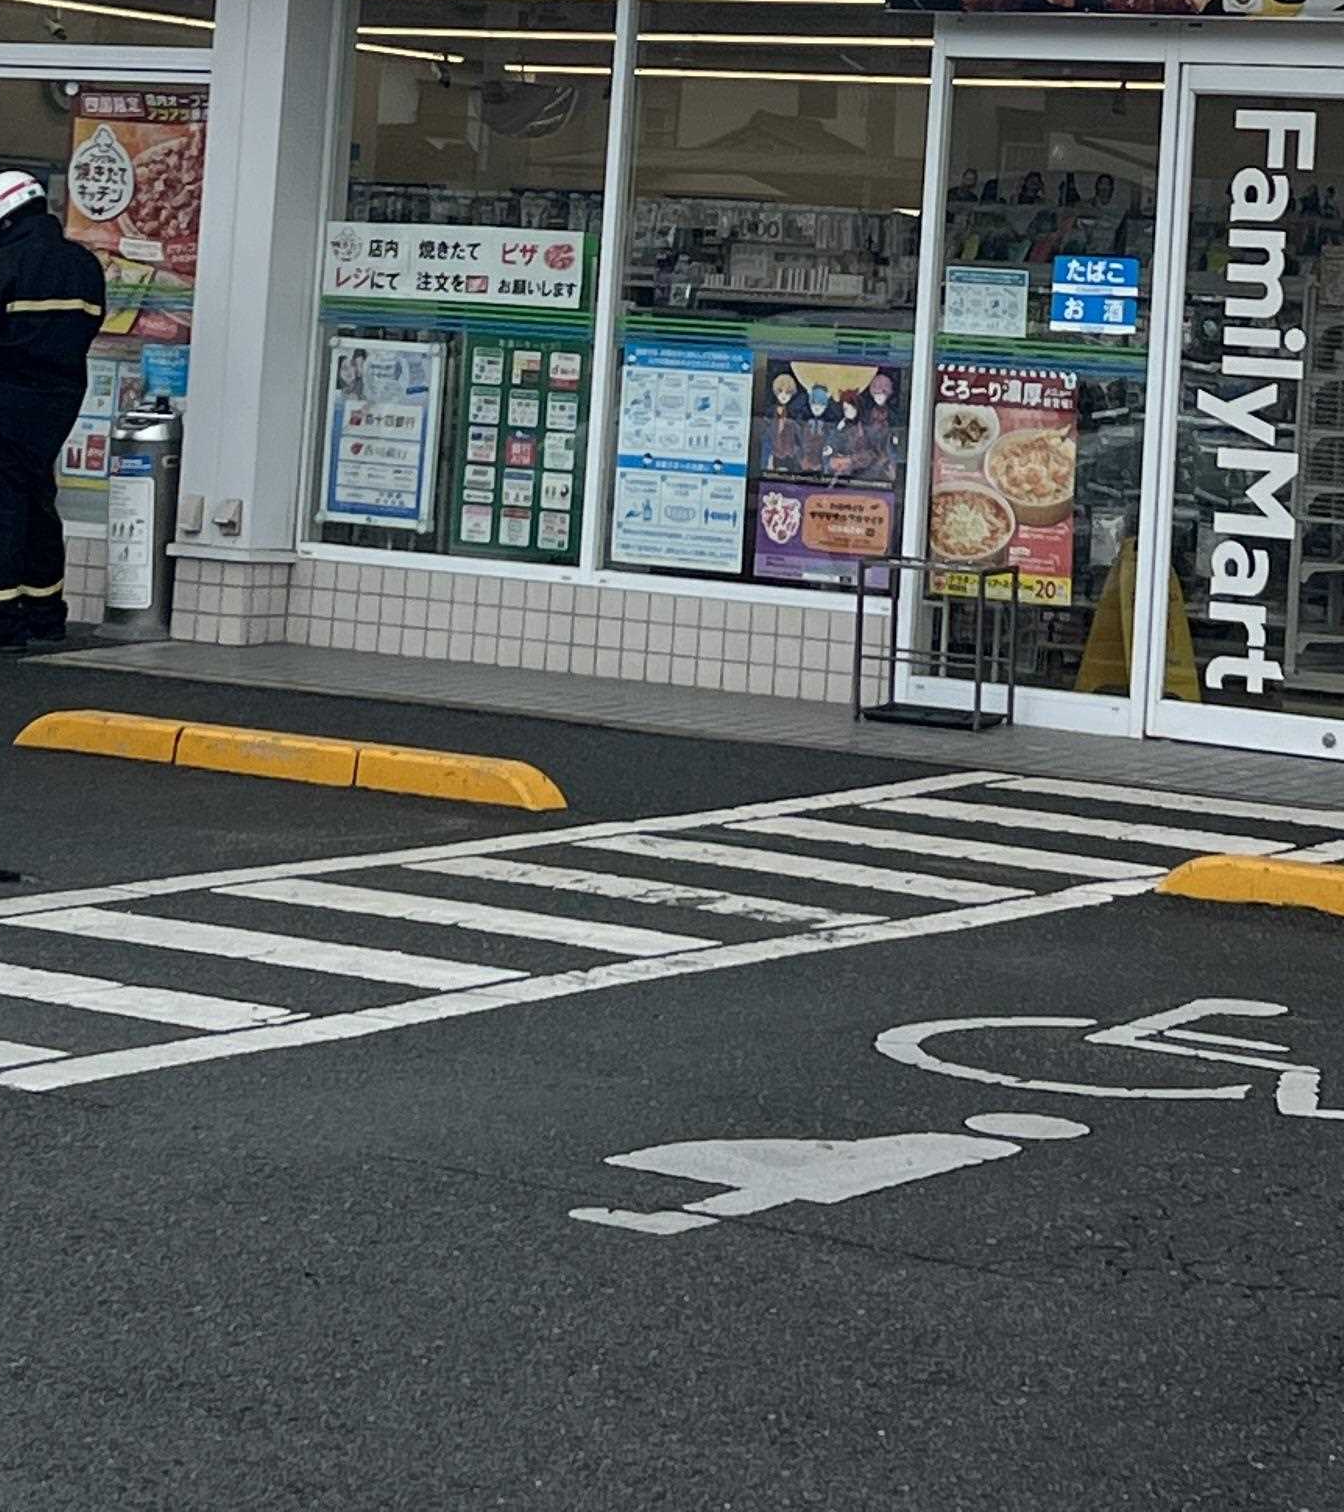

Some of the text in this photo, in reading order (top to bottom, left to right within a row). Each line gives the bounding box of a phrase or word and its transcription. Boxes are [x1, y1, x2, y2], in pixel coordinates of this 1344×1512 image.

[367, 239, 399, 259] 店内
[418, 239, 481, 260] 焼きたて
[501, 243, 539, 266] ピザ
[335, 266, 578, 299] レジにて 注文を お願いします
[1065, 258, 1126, 284] たばこ
[1063, 296, 1124, 324] お酒
[939, 374, 1043, 407] とろーり濃厚
[1197, 108, 1318, 693] FamilyMart
